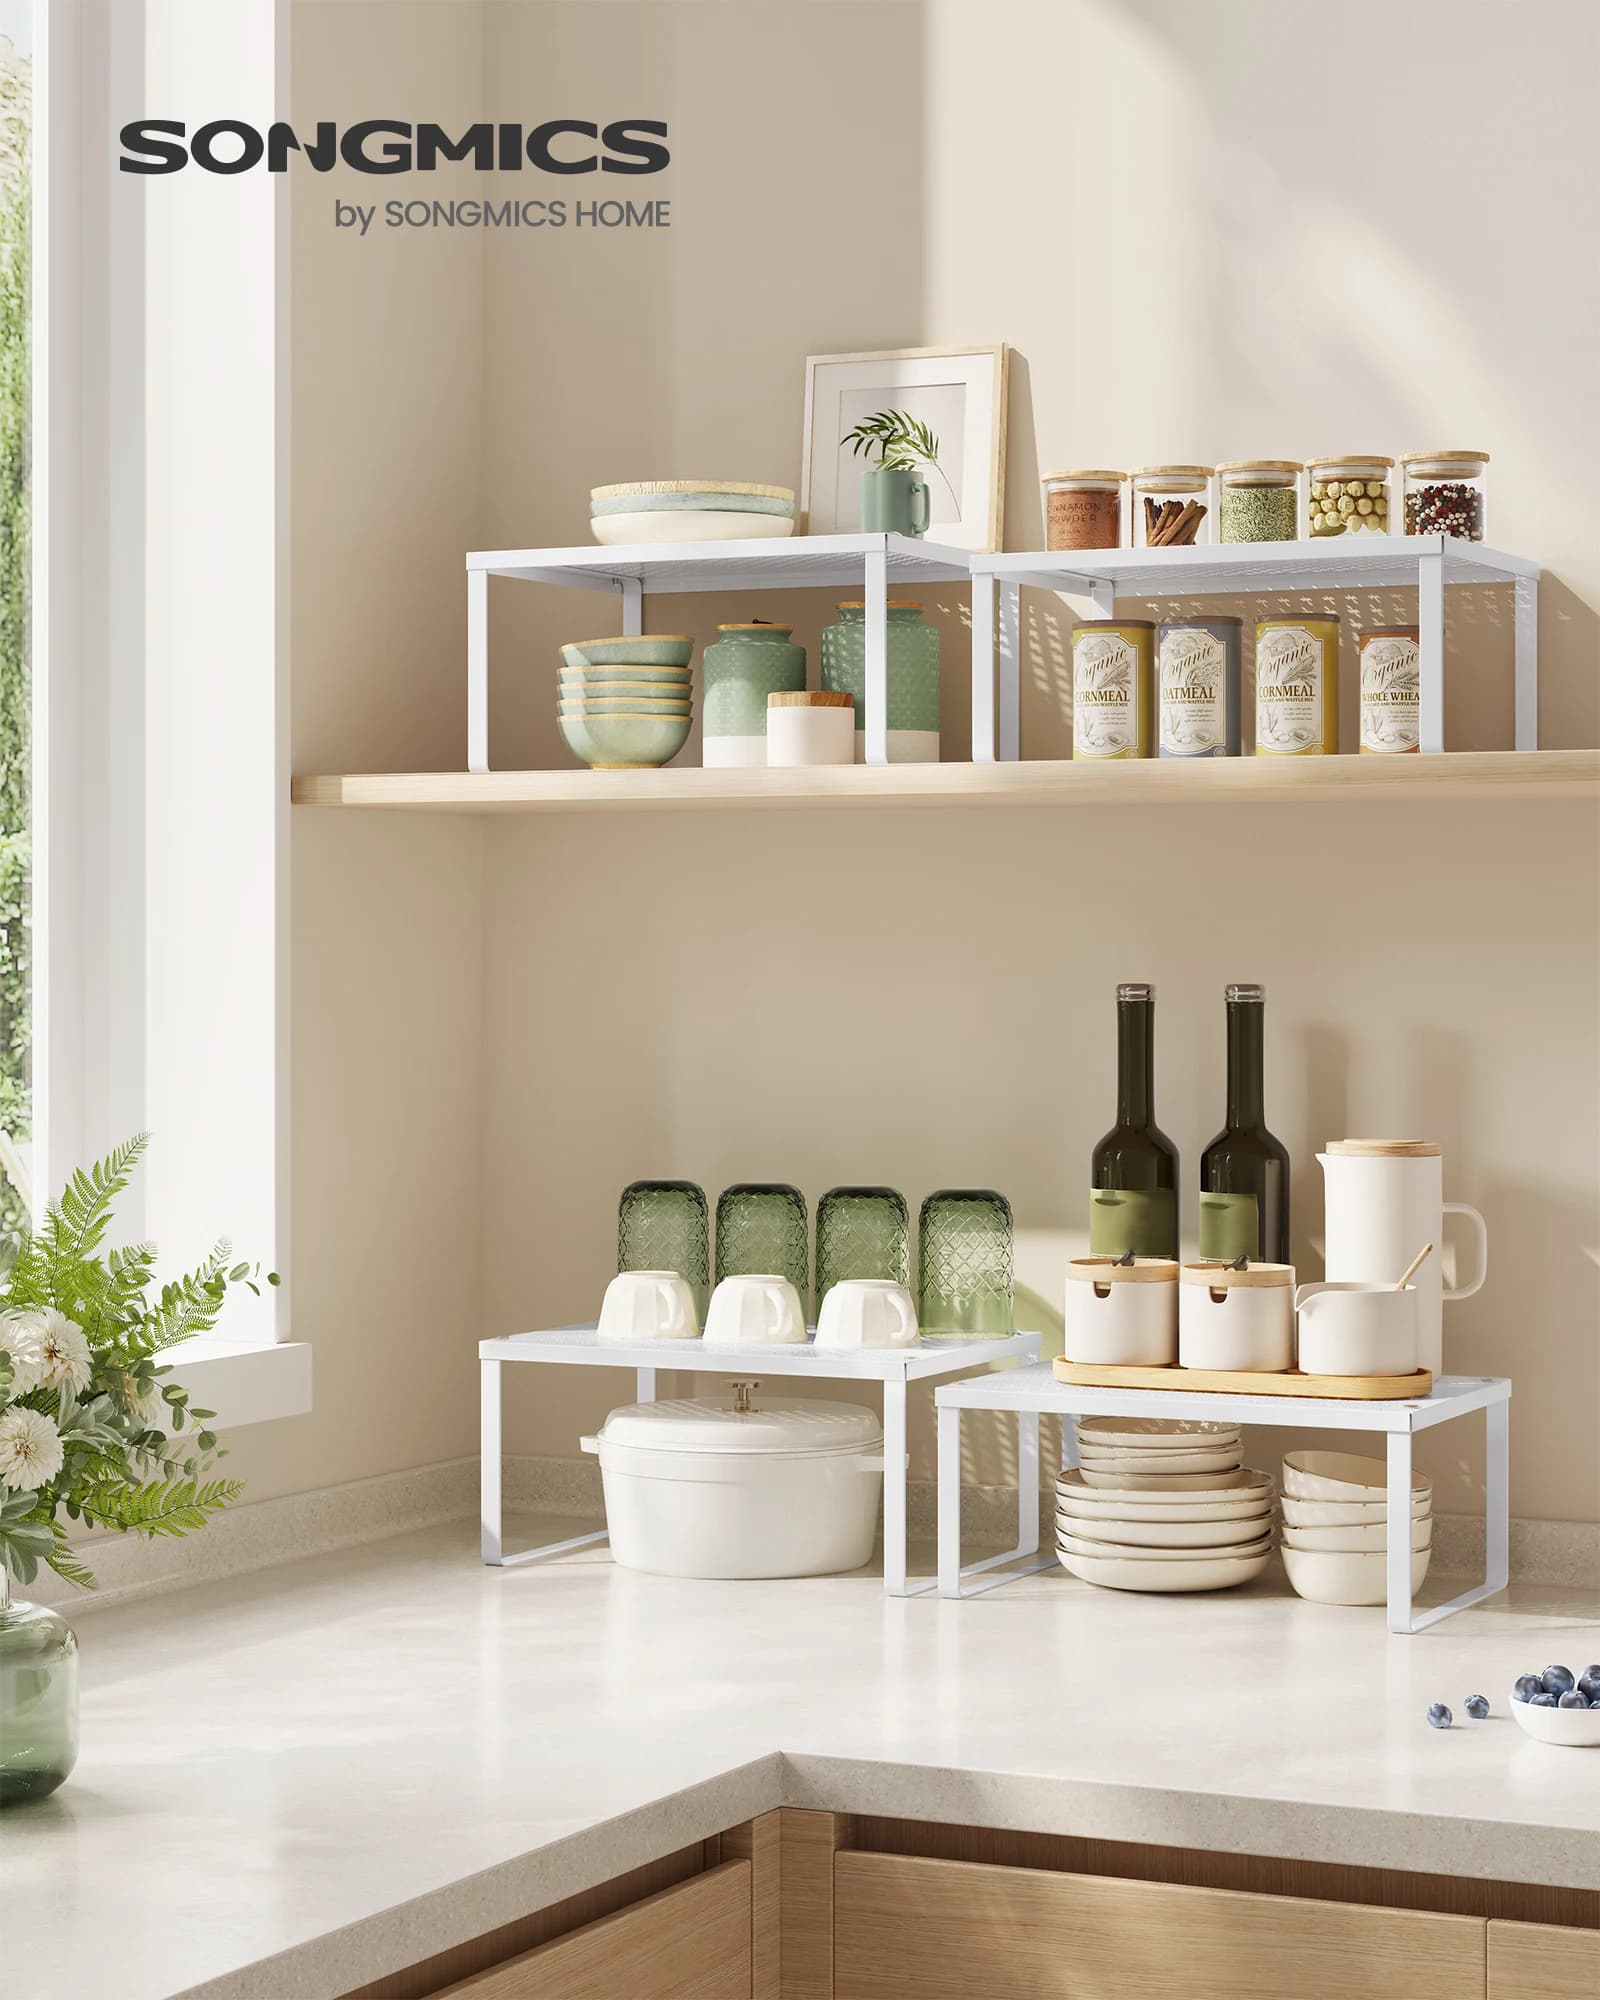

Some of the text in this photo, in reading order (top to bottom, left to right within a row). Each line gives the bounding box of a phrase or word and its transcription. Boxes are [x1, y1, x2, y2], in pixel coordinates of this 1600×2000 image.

[1049, 513, 1097, 523] POWDER
[1075, 690, 1130, 703] CORNMEAL
[1162, 686, 1216, 700] OATMEAL
[1258, 684, 1316, 698] CORNMEAL
[1390, 691, 1420, 702] WHEA
